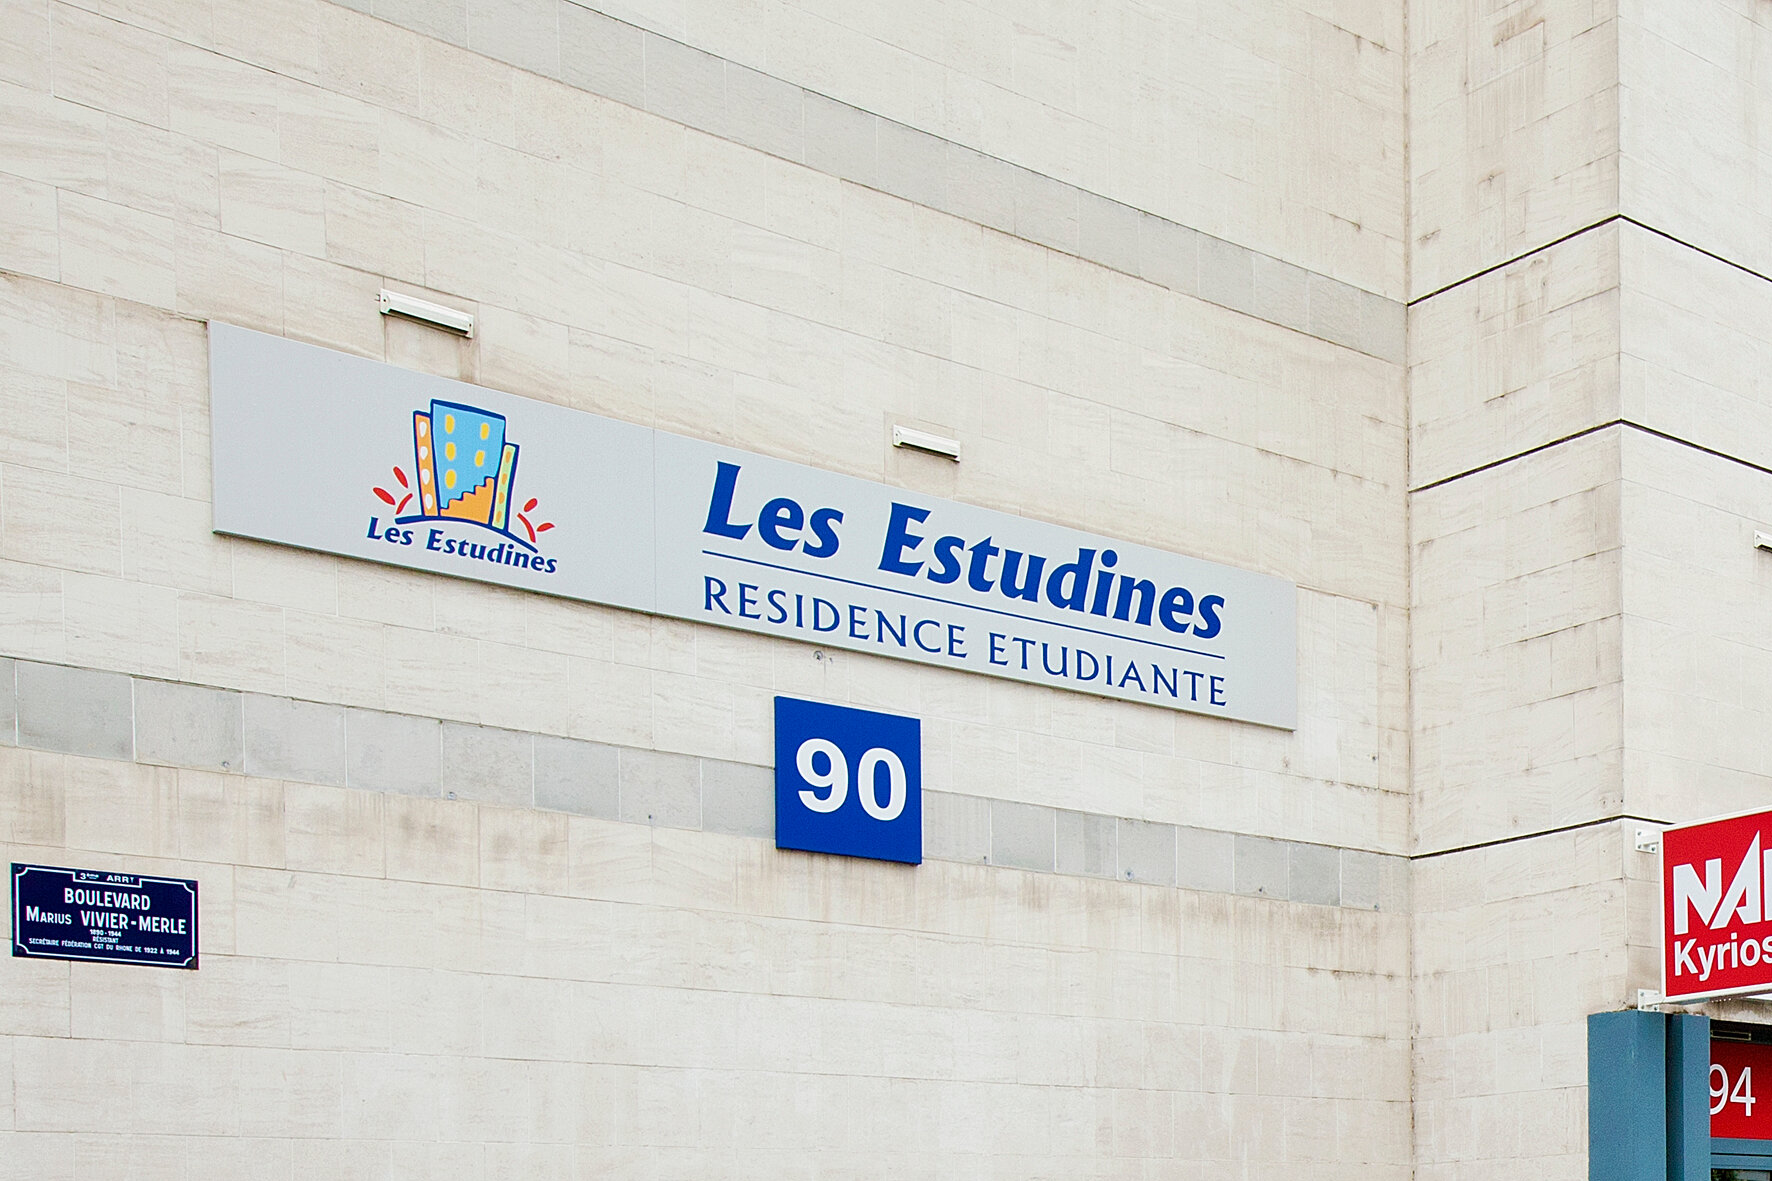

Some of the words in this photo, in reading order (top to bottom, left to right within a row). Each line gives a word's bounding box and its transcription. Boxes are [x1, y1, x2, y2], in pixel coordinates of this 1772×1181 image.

[366, 516, 414, 546] Les
[426, 528, 558, 574] Estudines
[703, 460, 844, 559] Les
[878, 502, 1225, 639] Estudines
[703, 575, 969, 658] RESIDENCE
[988, 631, 1227, 707] ETUDIANTE
[796, 737, 907, 822] 90
[64, 887, 151, 911] BOULEVARD
[1709, 1063, 1756, 1117] 94
